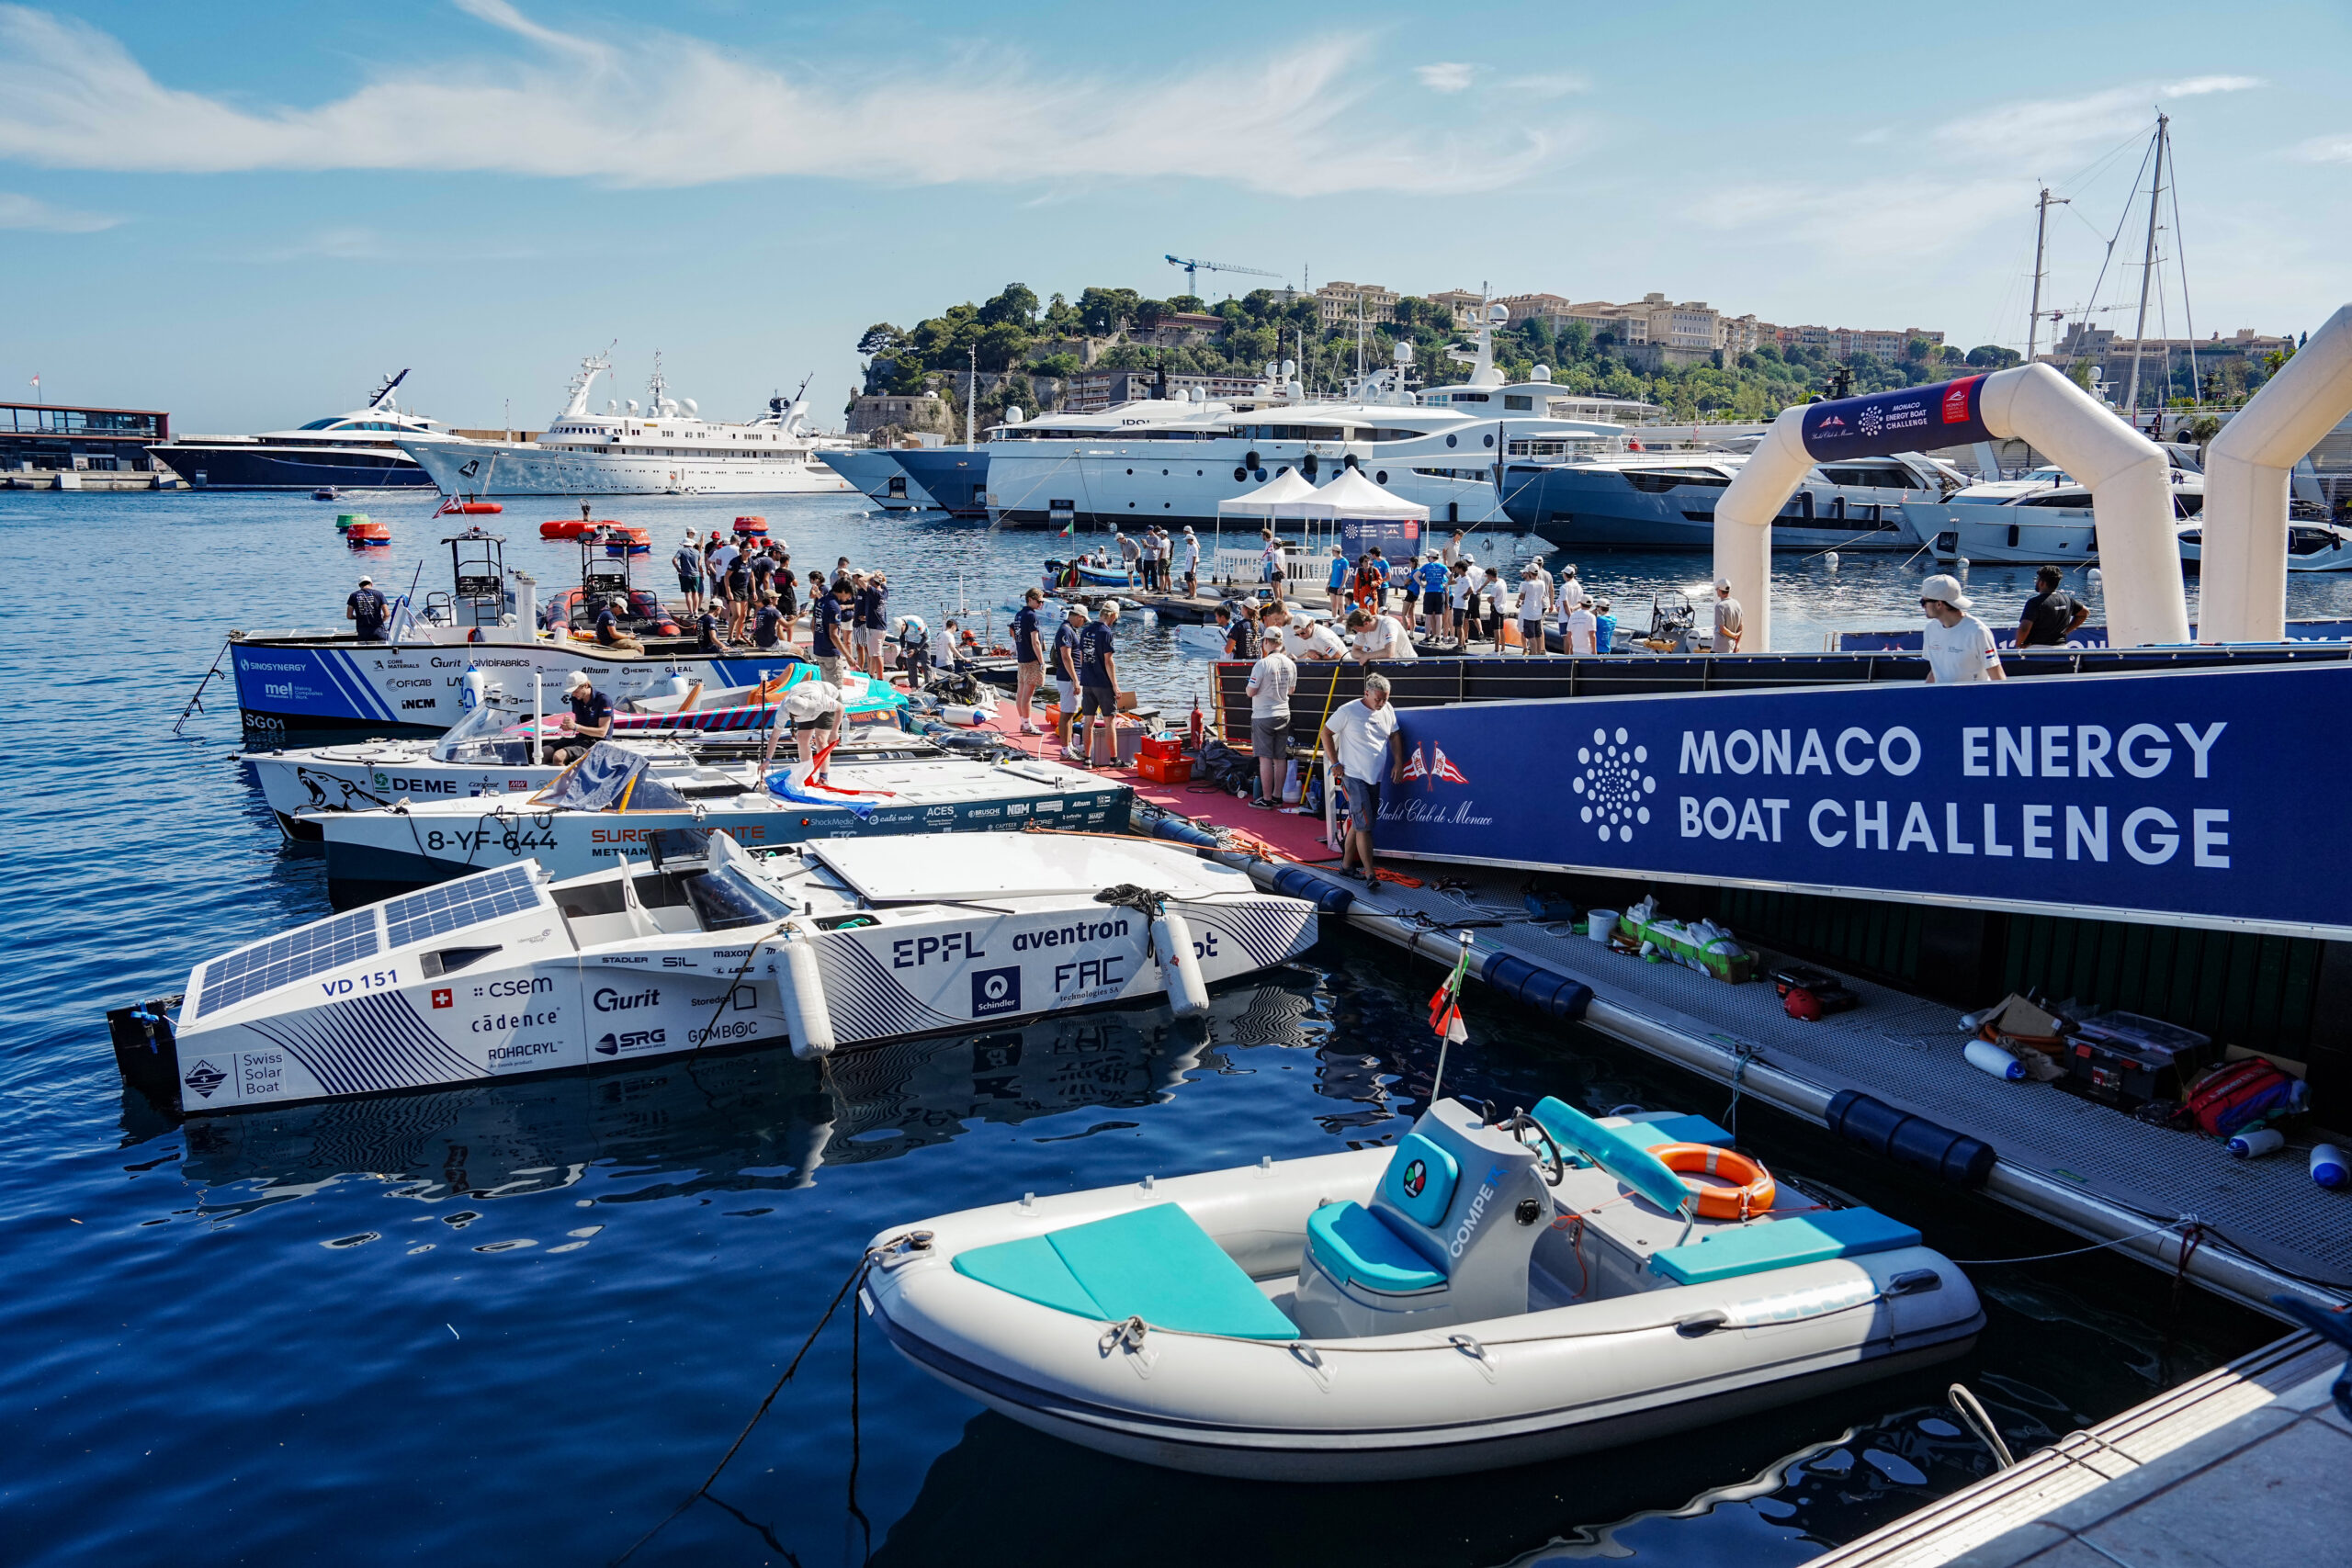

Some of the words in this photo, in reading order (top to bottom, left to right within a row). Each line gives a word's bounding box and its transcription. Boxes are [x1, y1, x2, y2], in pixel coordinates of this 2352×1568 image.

[1893, 401, 1921, 412] MONACO
[1885, 412, 1908, 422] ENERGY
[1910, 409, 1927, 418] BOAT
[1886, 418, 1928, 430] CHALLENGE
[250, 661, 306, 671] SINOSYNERGY
[430, 657, 461, 668] Gurit
[1679, 725, 1922, 777] MONACO
[1962, 721, 2228, 779] ENERGY
[392, 777, 458, 795] DEME
[926, 806, 955, 817] ACES
[1007, 803, 1030, 816] NGM
[1404, 797, 1433, 822] Club
[1433, 806, 1446, 823] de
[1447, 800, 1493, 826] Monaco
[879, 814, 897, 822] café
[1679, 795, 1792, 843] BOAT
[1807, 798, 2231, 869] CHALLENGE
[427, 830, 558, 851] 8-YF-644
[1012, 919, 1129, 952] aventron
[893, 931, 986, 969] EPFL
[1055, 955, 1124, 993] FAC
[322, 978, 354, 997] VD
[360, 969, 398, 988] 151
[489, 976, 553, 998] csem
[594, 987, 661, 1011] Gurit
[1059, 987, 1108, 1002] technologies
[1109, 986, 1119, 994] SA
[978, 998, 1016, 1010] Schindler
[619, 1028, 666, 1048] SRG
[243, 1053, 283, 1066] Swiss
[245, 1066, 283, 1080] Solar
[246, 1081, 280, 1095] Boat
